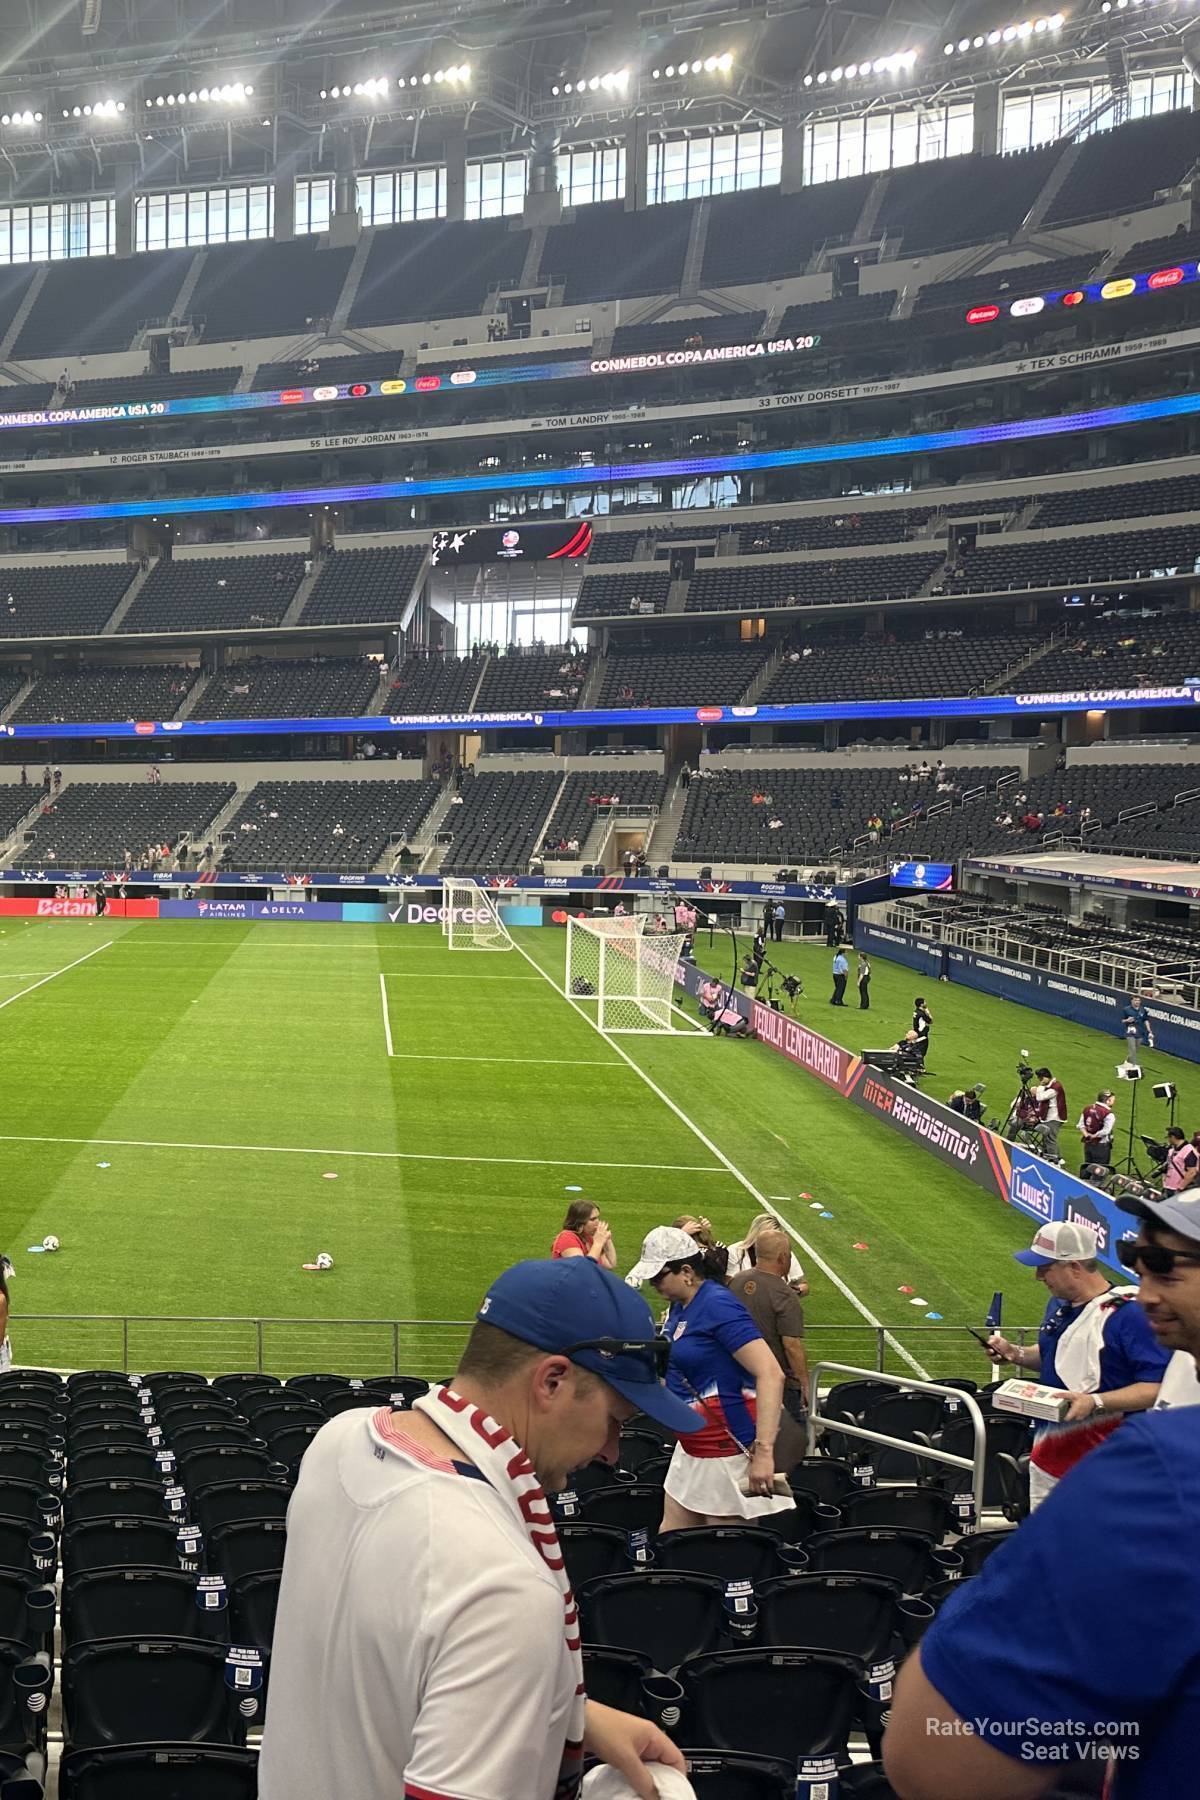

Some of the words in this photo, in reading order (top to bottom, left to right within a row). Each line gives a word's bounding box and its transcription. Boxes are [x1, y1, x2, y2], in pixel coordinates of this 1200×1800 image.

[590, 355, 665, 373] CONMEBOL
[665, 352, 702, 365] COPA
[702, 345, 765, 362] AMERICA
[767, 340, 795, 353] USA
[1030, 359, 1056, 371] TEX
[1058, 346, 1122, 368] SCHRAMM
[758, 398, 771, 408] 33
[774, 394, 804, 406] TONY
[806, 387, 860, 403] DORSETT
[49, 408, 78, 423] COPA
[78, 406, 127, 420] AMERICA
[128, 404, 149, 416] USA
[545, 417, 567, 427] TOM
[569, 413, 610, 426] LANDRY
[310, 440, 321, 448] 55
[324, 438, 341, 447] LEE
[341, 436, 360, 446] ROY
[360, 433, 397, 445] JORDAN
[109, 456, 118, 464] 12
[121, 454, 148, 463] ROGER
[150, 450, 190, 462] STAUBACH
[209, 903, 246, 911] LATAM
[271, 906, 305, 914] DELTA
[407, 904, 491, 924] Degree
[753, 1004, 784, 1048] TEQUILA
[785, 1021, 840, 1083] CENTENARIO
[862, 1078, 894, 1114] INTER
[1015, 1174, 1051, 1215] LOWE'S
[42, 1513, 61, 1527] Lite
[32, 1553, 54, 1570] Lite
